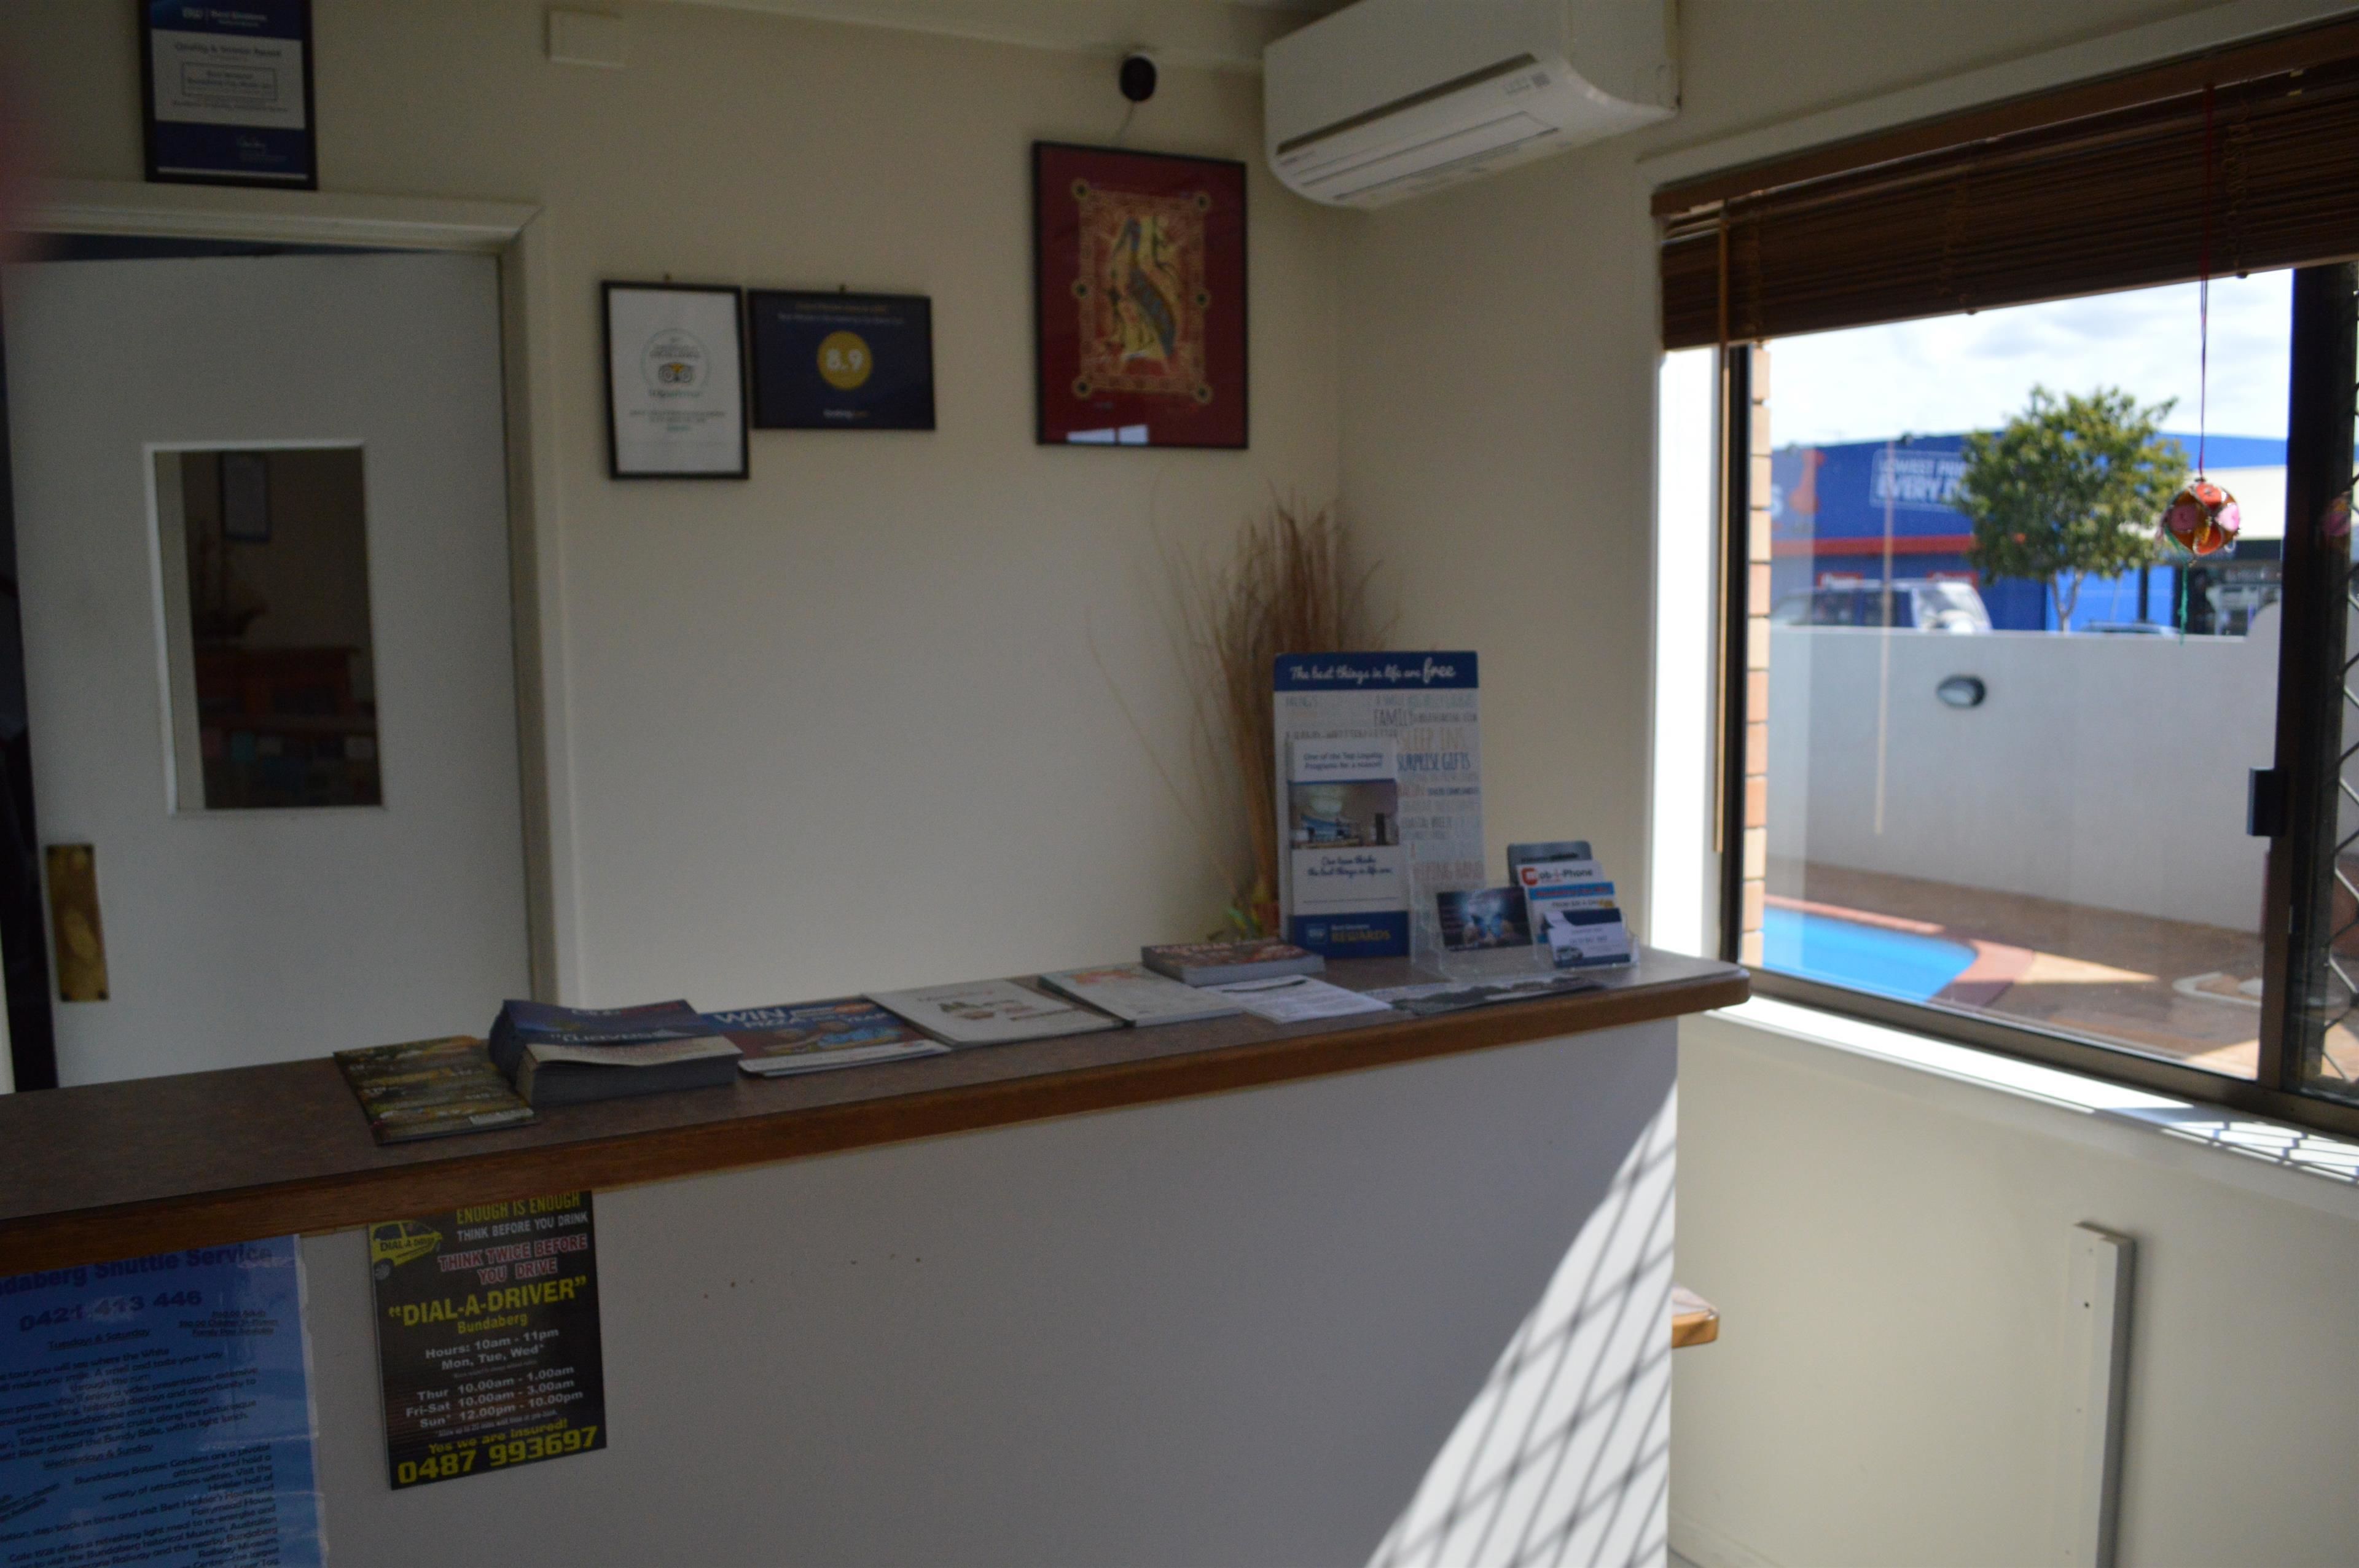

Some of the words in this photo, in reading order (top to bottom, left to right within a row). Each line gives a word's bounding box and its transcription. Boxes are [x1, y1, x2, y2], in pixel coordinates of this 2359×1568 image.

[1290, 665, 1309, 680] The
[1312, 665, 1334, 679] best
[1336, 663, 1369, 685] things
[1372, 666, 1382, 678] in
[1385, 663, 1402, 683] life
[1423, 657, 1456, 684] free
[1441, 752, 1470, 770] GIFTS
[714, 1008, 787, 1024] WIN
[456, 1201, 509, 1225] ENOUGH
[513, 1198, 526, 1217] IS
[529, 1190, 580, 1214] ENOUGH
[457, 1227, 489, 1242] THINK
[492, 1220, 531, 1237] BEFORE
[534, 1217, 555, 1230] YOU
[558, 1211, 588, 1227] DRINK
[437, 1250, 483, 1273] THINK
[485, 1241, 531, 1265] TWICE
[534, 1233, 587, 1258] BEFORE
[0, 1266, 87, 1295] daberg
[95, 1252, 179, 1279] Shuttle
[186, 1244, 272, 1266] Service
[477, 1265, 507, 1285] YOU
[515, 1257, 558, 1279] DRIVE
[19, 1303, 84, 1332] 0421
[95, 1295, 146, 1315] 413
[152, 1290, 203, 1308] 446
[458, 1313, 529, 1334] Bundaberg
[47, 1335, 93, 1350] Tuesdays
[106, 1327, 152, 1343] Saturday
[425, 1344, 471, 1359] Hours:
[474, 1337, 511, 1351] 10am
[523, 1328, 559, 1342] 11pm
[33, 1367, 51, 1377] you
[123, 1351, 138, 1362] the
[95, 1368, 103, 1376] A
[131, 1361, 151, 1371] and
[179, 1354, 200, 1365] your
[203, 1351, 224, 1361] way
[441, 1357, 474, 1370] Mon,
[477, 1352, 507, 1363] Tue,
[166, 1388, 187, 1398] and
[417, 1389, 450, 1402] Thur
[458, 1377, 515, 1394] 10.00am
[526, 1365, 575, 1381] 1.00am
[405, 1402, 450, 1418] Fri-Sat
[458, 1391, 515, 1407] 10.00am
[526, 1379, 575, 1395] 3.00am
[460, 1403, 516, 1421] 12.00pm
[528, 1390, 584, 1408] 10.00pm
[127, 1406, 146, 1417] and
[155, 1413, 184, 1424] along
[47, 1441, 83, 1453] aboard
[429, 1441, 453, 1454] Yes
[457, 1437, 477, 1448] we
[482, 1432, 507, 1445] are
[511, 1418, 568, 1438] insured!
[117, 1444, 154, 1456] Sunday
[397, 1449, 477, 1484] 0487
[489, 1426, 598, 1467] 993697
[74, 1469, 130, 1485] Bundaberg
[131, 1462, 168, 1475] Botanic
[170, 1455, 209, 1467] Gardens
[211, 1452, 227, 1461] are
[173, 1464, 219, 1478] attraction
[221, 1459, 240, 1469] and
[242, 1454, 263, 1465] hold
[257, 1464, 273, 1473] the
[118, 1508, 138, 1519] and
[257, 1504, 276, 1515] and
[87, 1542, 141, 1559] Bundaberg
[152, 1545, 173, 1558] and
